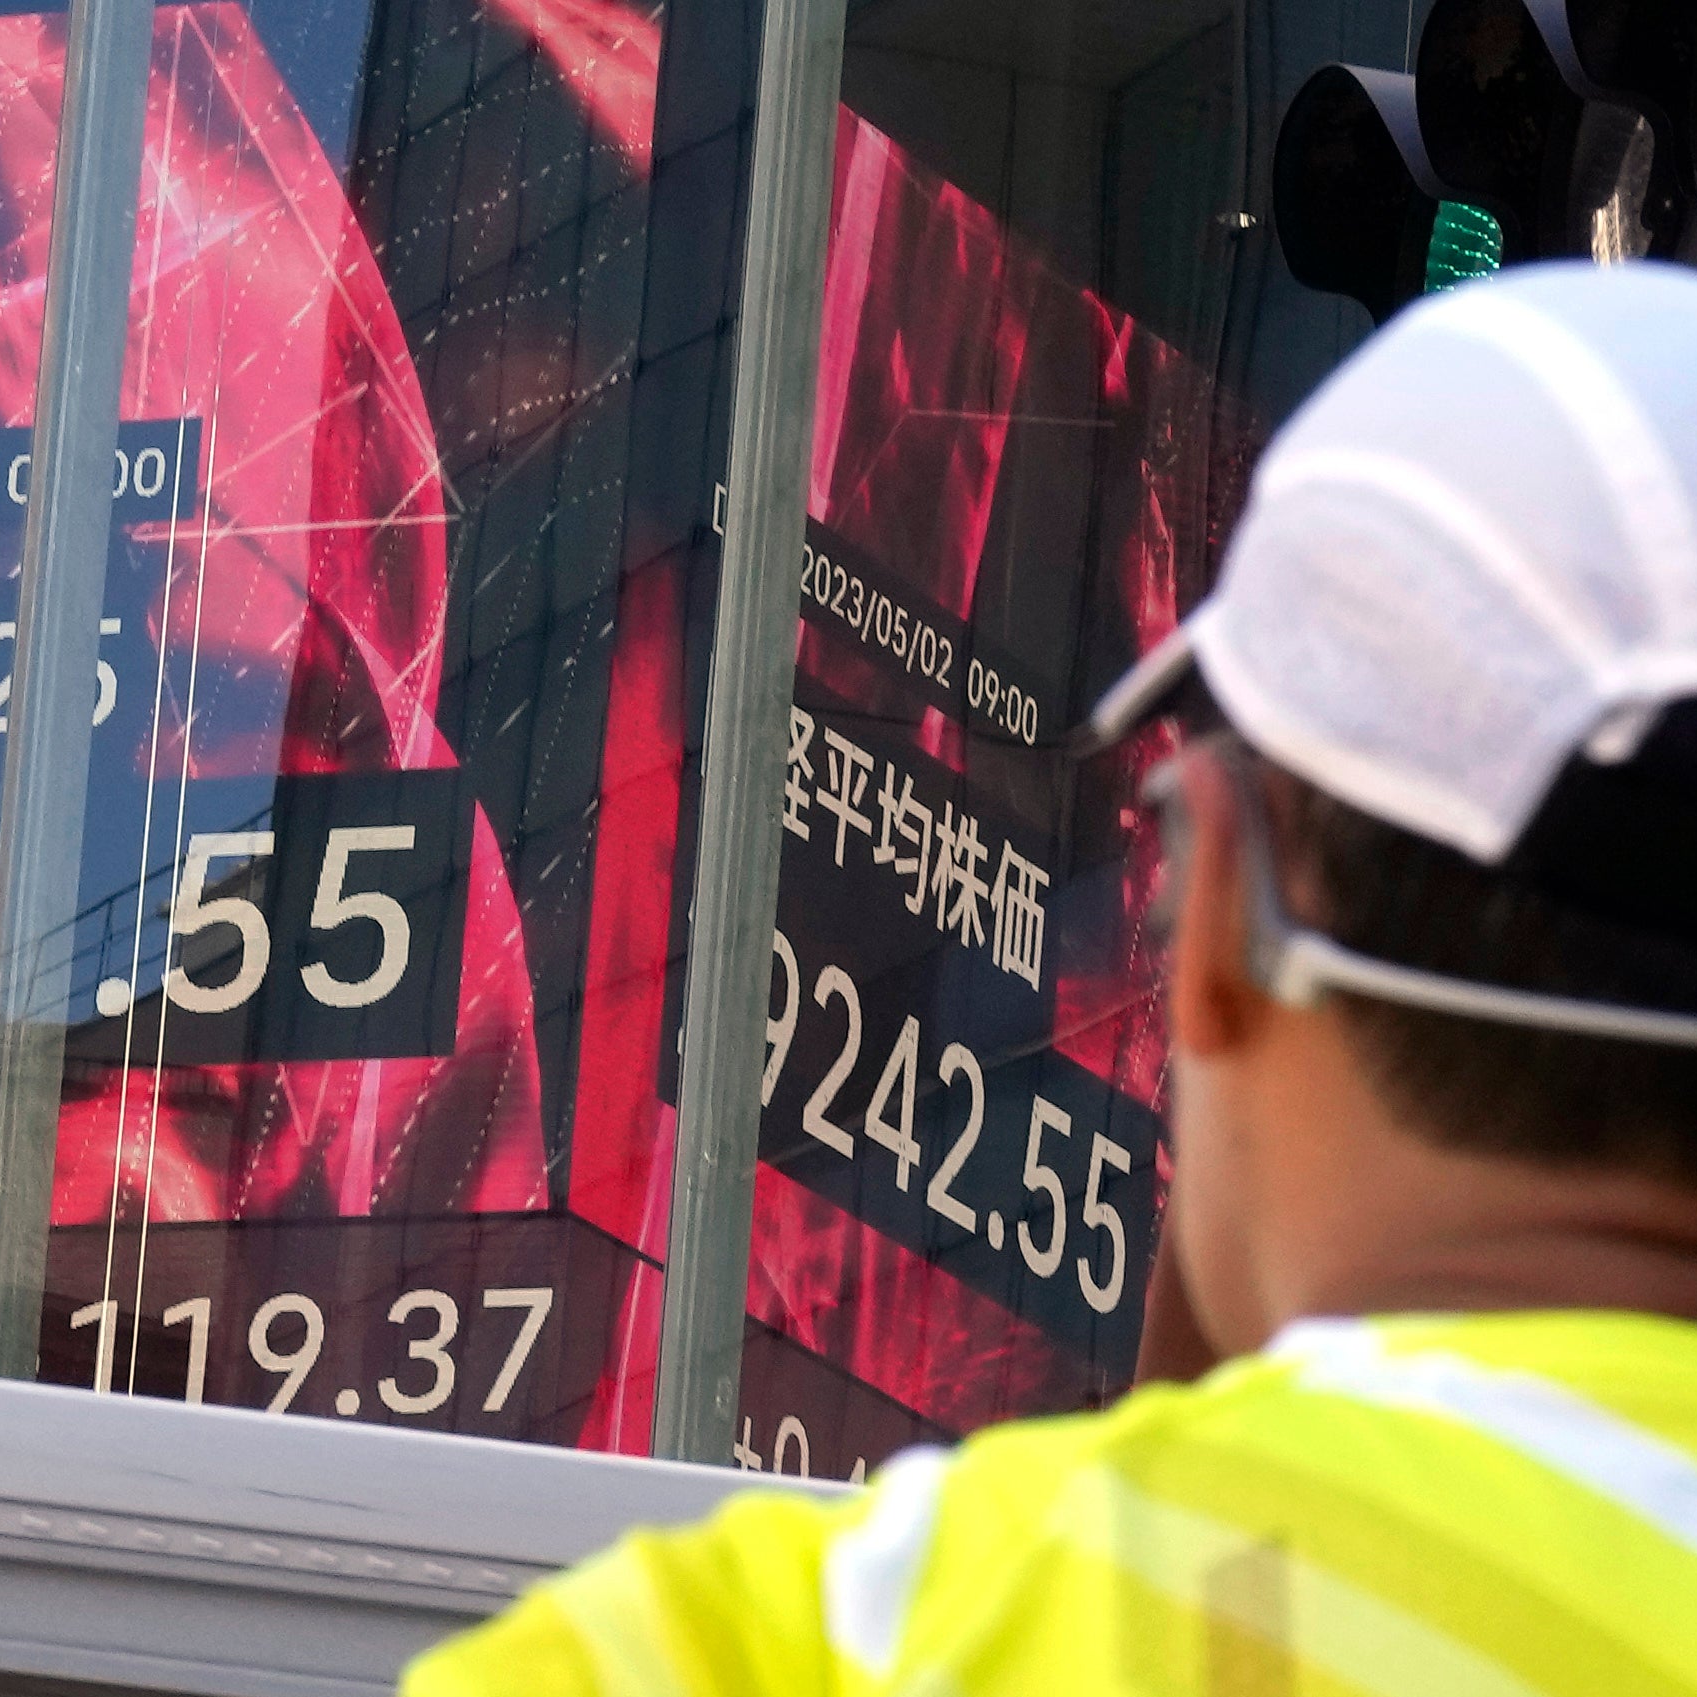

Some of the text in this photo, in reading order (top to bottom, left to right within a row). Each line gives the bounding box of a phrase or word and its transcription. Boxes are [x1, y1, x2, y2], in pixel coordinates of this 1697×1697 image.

[799, 541, 1039, 745] 2023/05/02 09:00
[760, 927, 1132, 1314] 9242.55
[69, 1287, 553, 1416] 119.37
